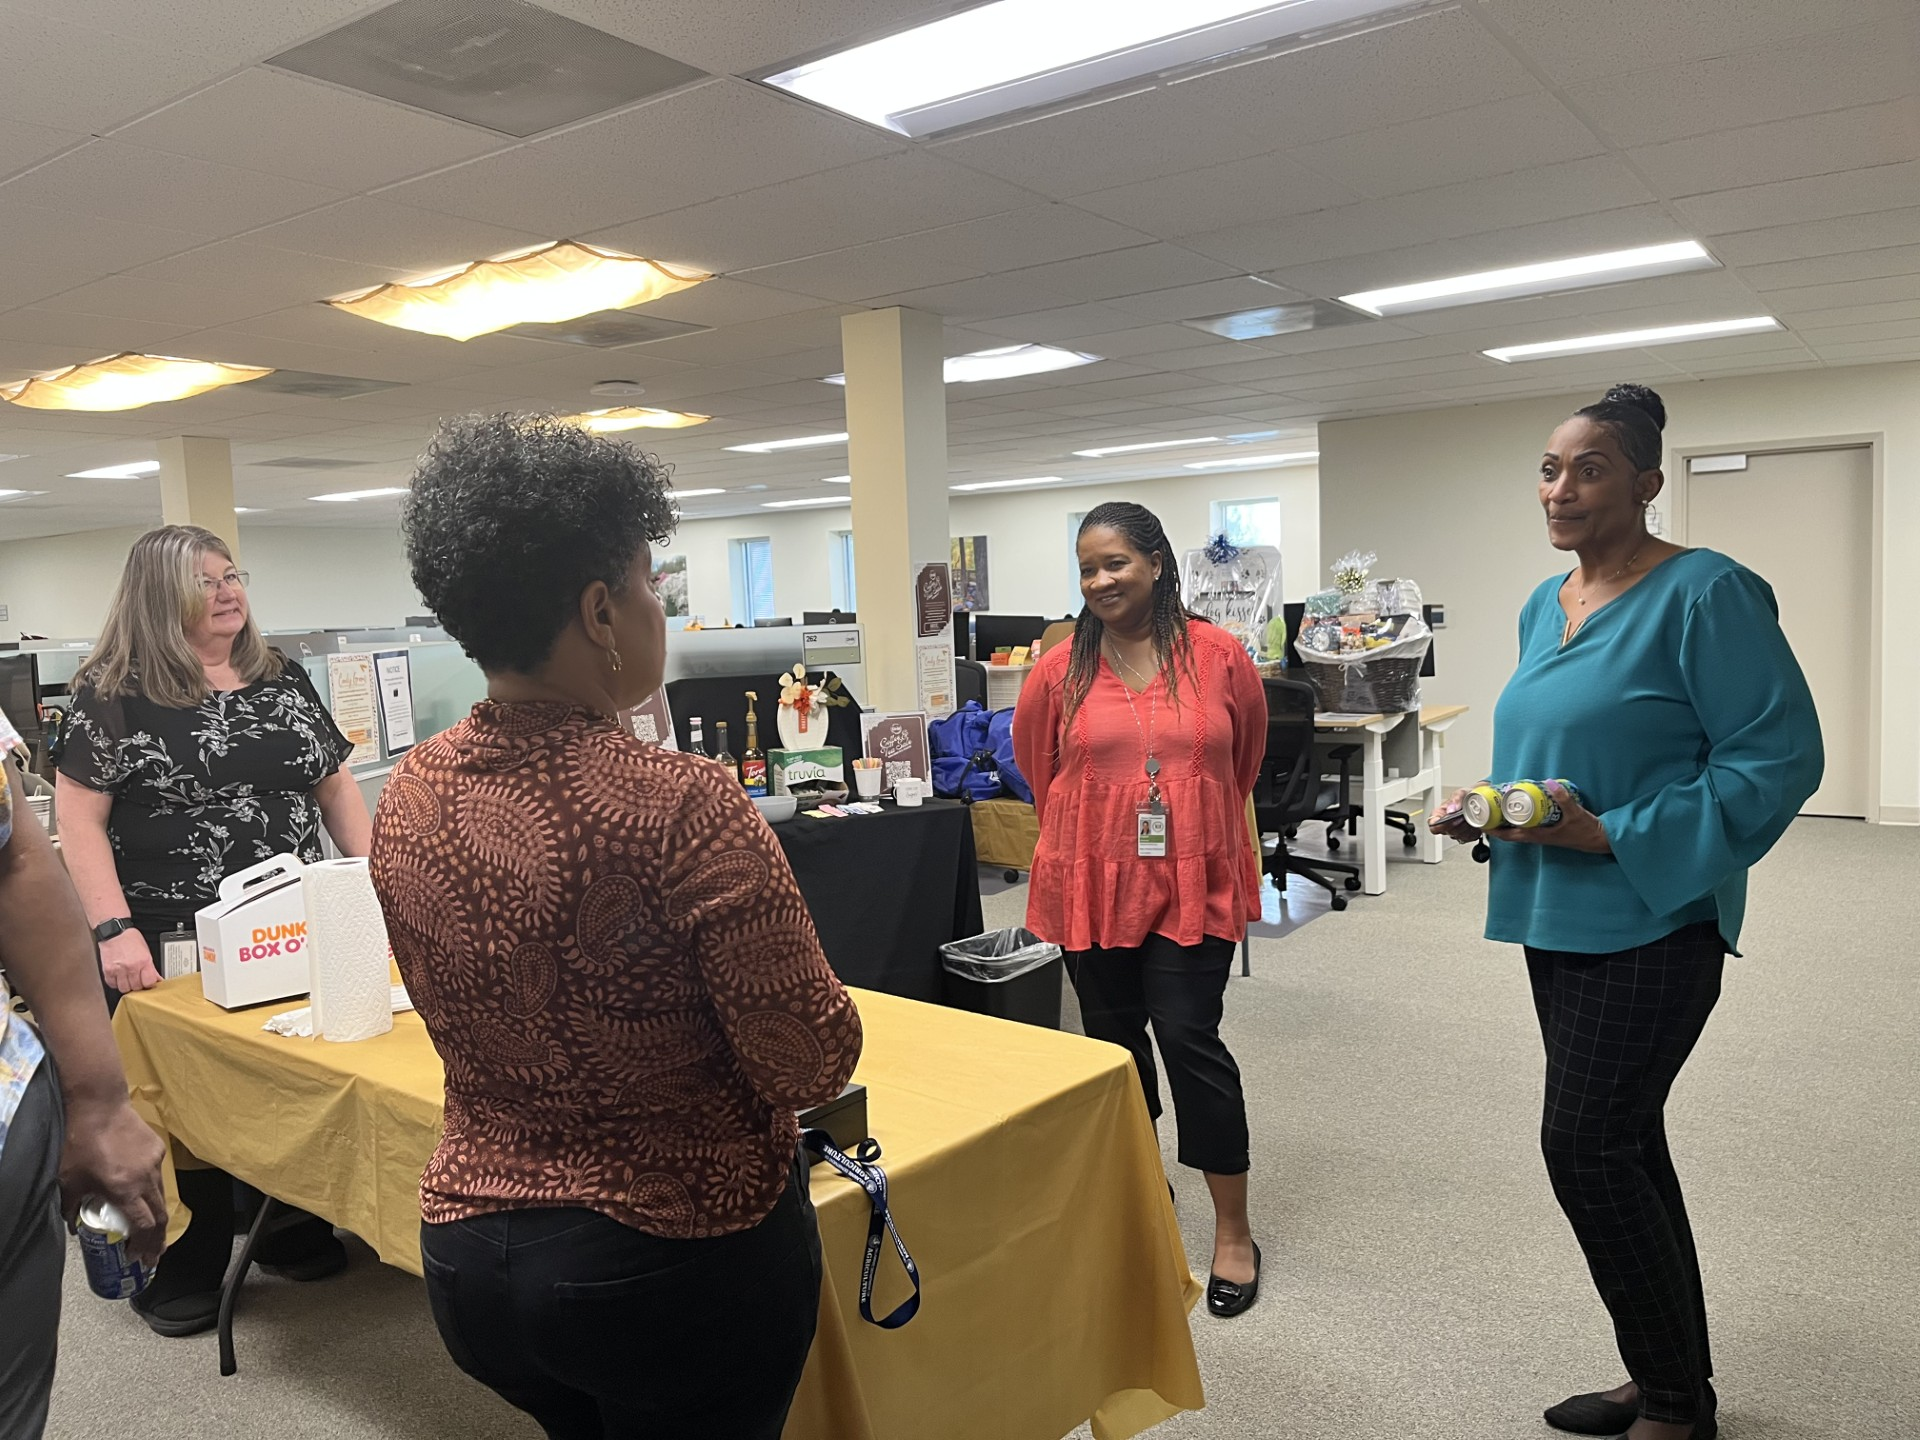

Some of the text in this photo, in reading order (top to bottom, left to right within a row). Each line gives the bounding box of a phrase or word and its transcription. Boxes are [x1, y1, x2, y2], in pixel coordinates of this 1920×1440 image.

[806, 635, 818, 643] 262
[386, 664, 401, 674] NOTICE
[239, 941, 281, 963] BOX
[823, 1144, 870, 1182] AGRICULTURE
[861, 1247, 873, 1304] AGRICULTURE
